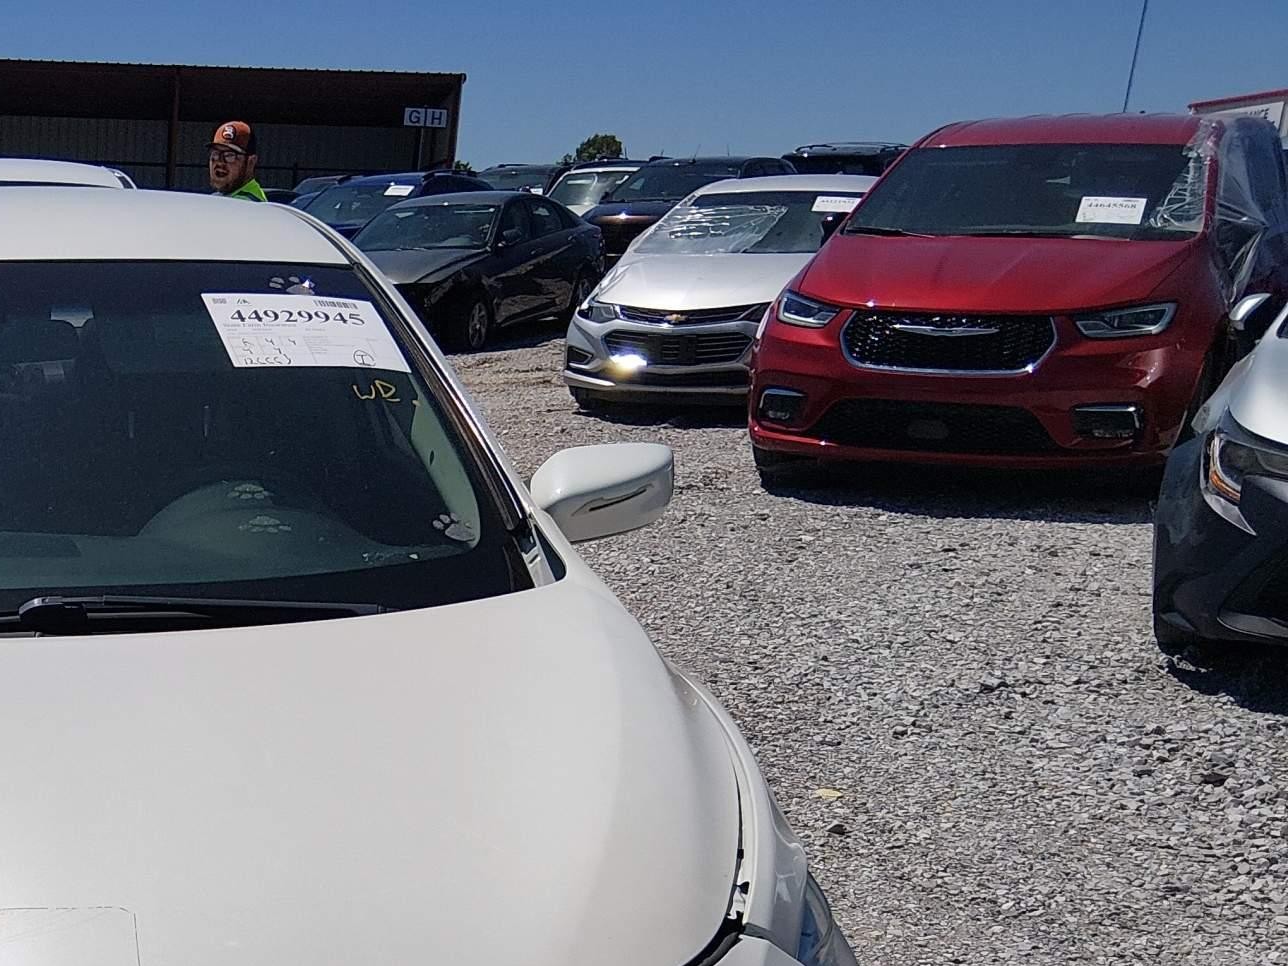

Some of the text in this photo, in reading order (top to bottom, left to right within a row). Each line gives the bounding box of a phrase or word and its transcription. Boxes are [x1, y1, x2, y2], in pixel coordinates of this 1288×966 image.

[409, 110, 443, 126] G H
[230, 309, 366, 326] 44929945
